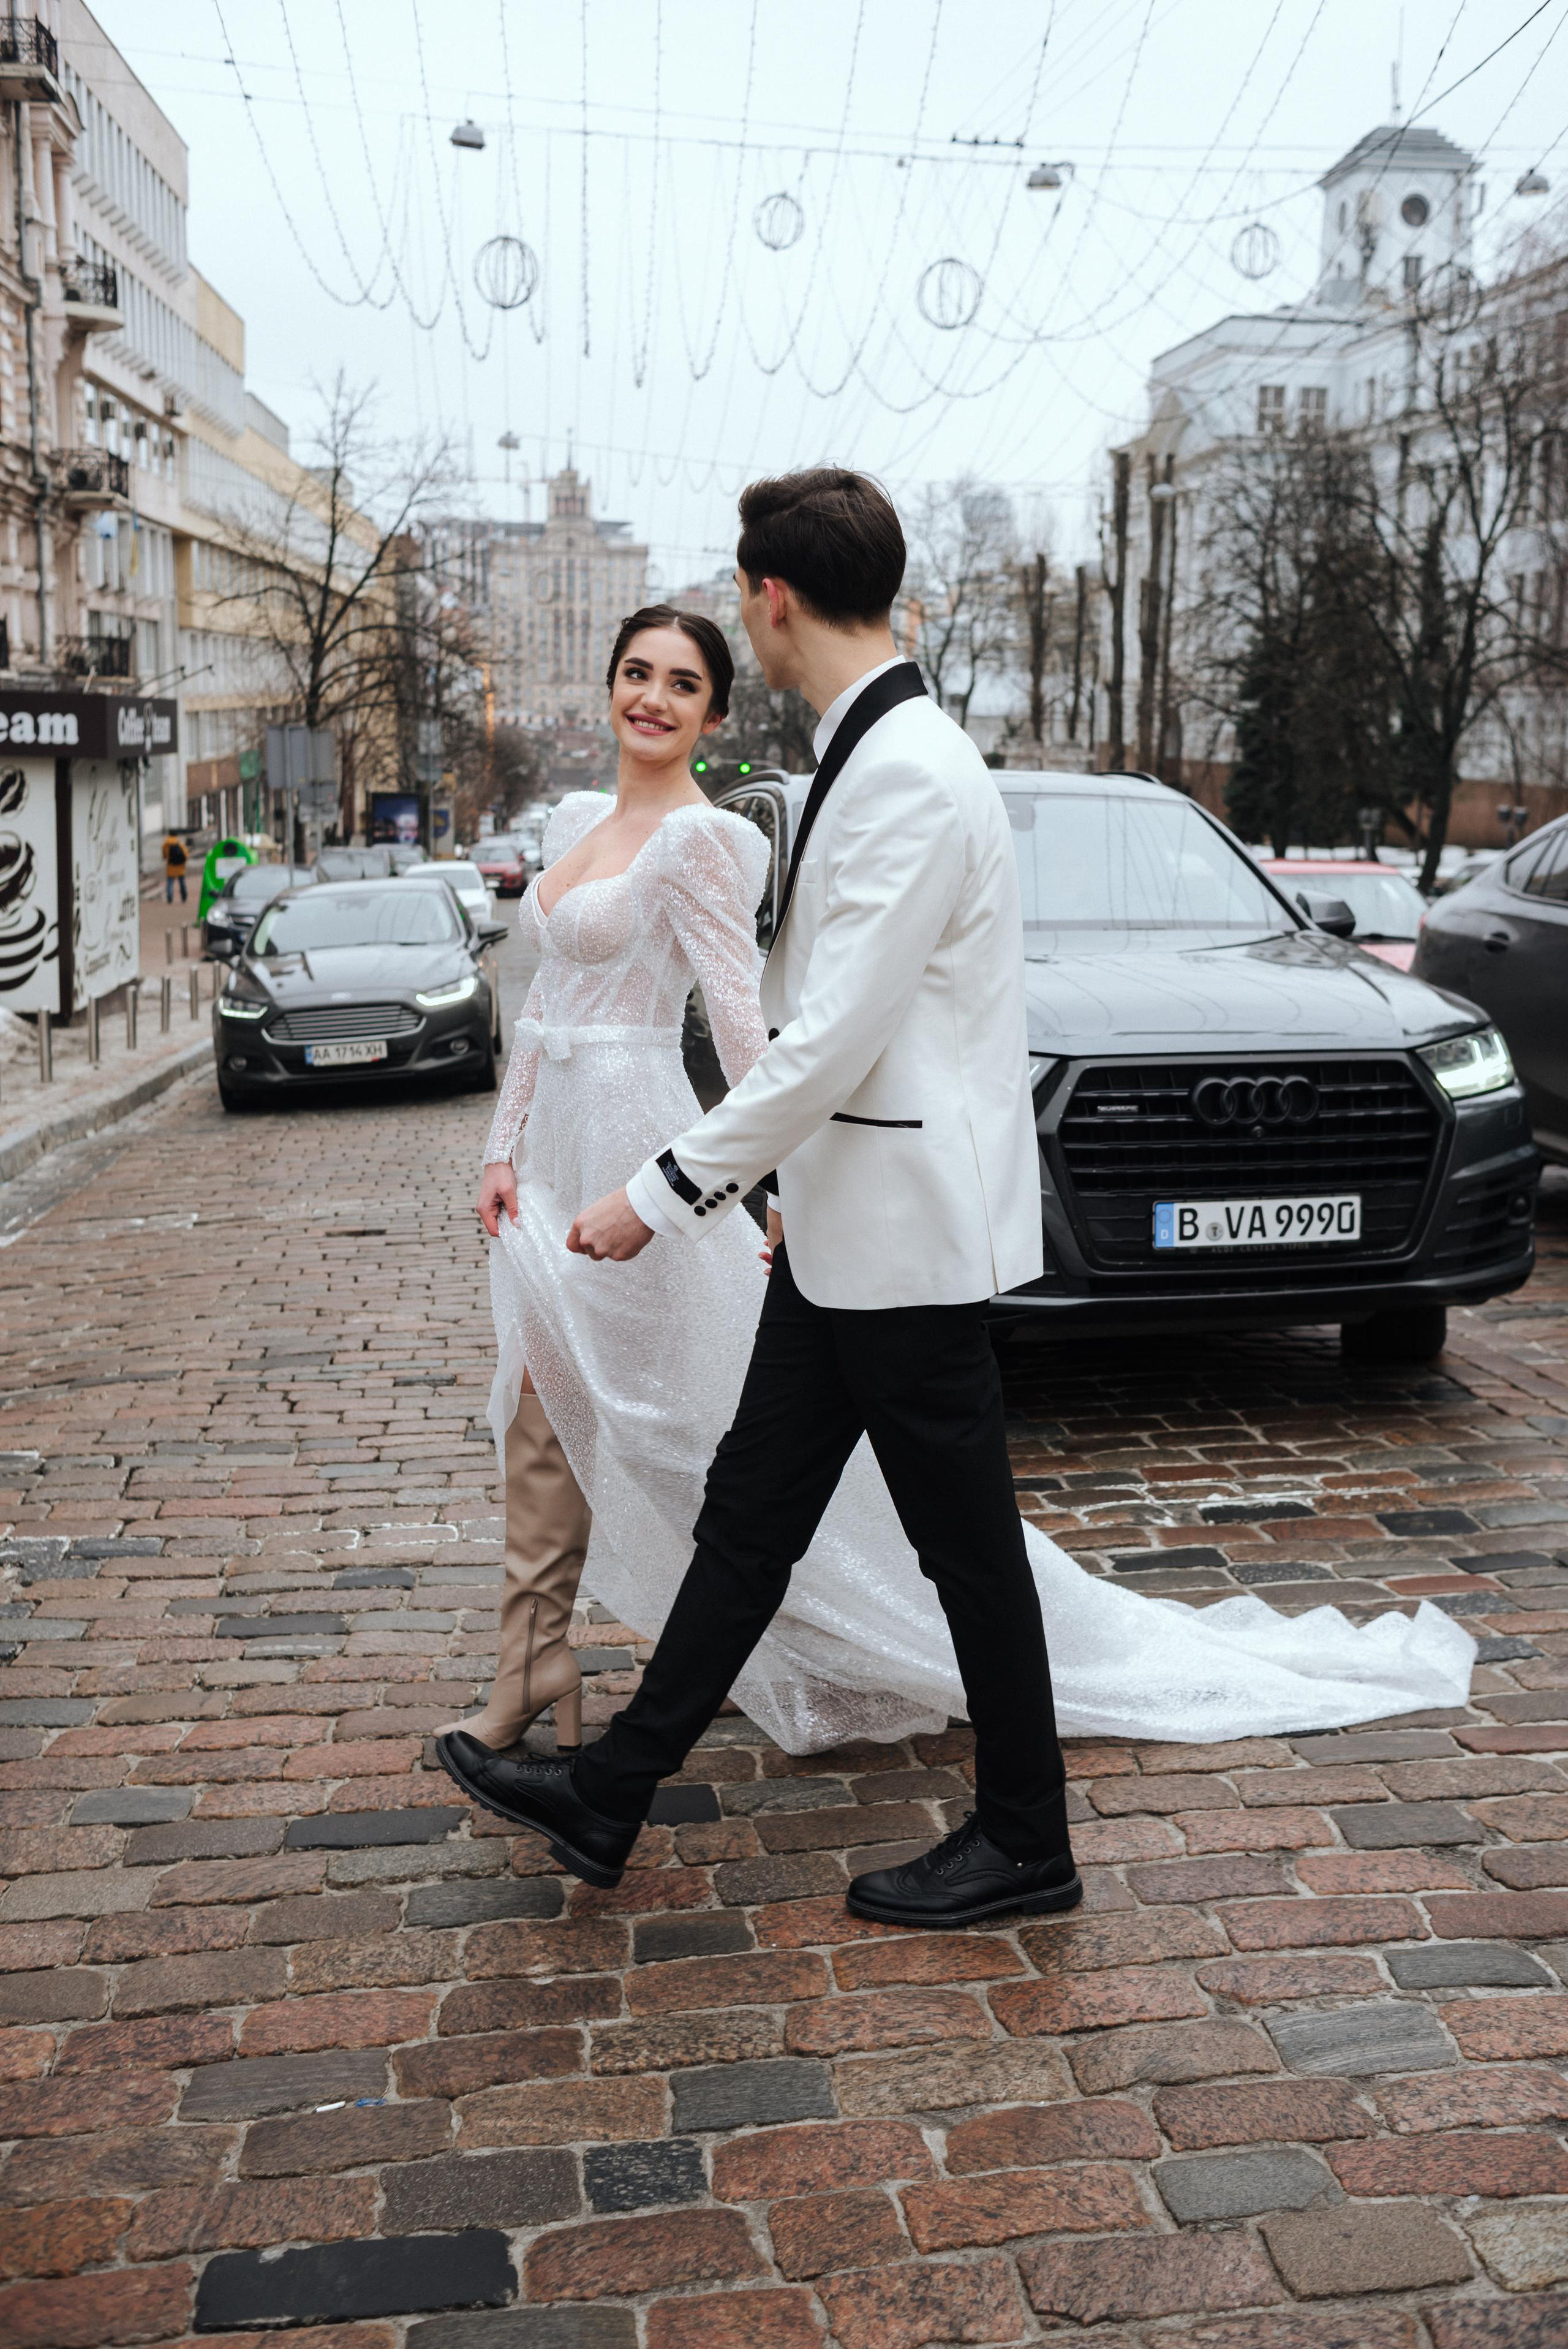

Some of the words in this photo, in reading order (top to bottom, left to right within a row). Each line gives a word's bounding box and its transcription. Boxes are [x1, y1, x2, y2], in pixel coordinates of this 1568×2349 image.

[314, 1048, 331, 1059] AA
[1179, 1208, 1199, 1241] B
[1225, 1206, 1267, 1239] VA
[1276, 1201, 1355, 1237] 9990
[1160, 1229, 1169, 1239] D
